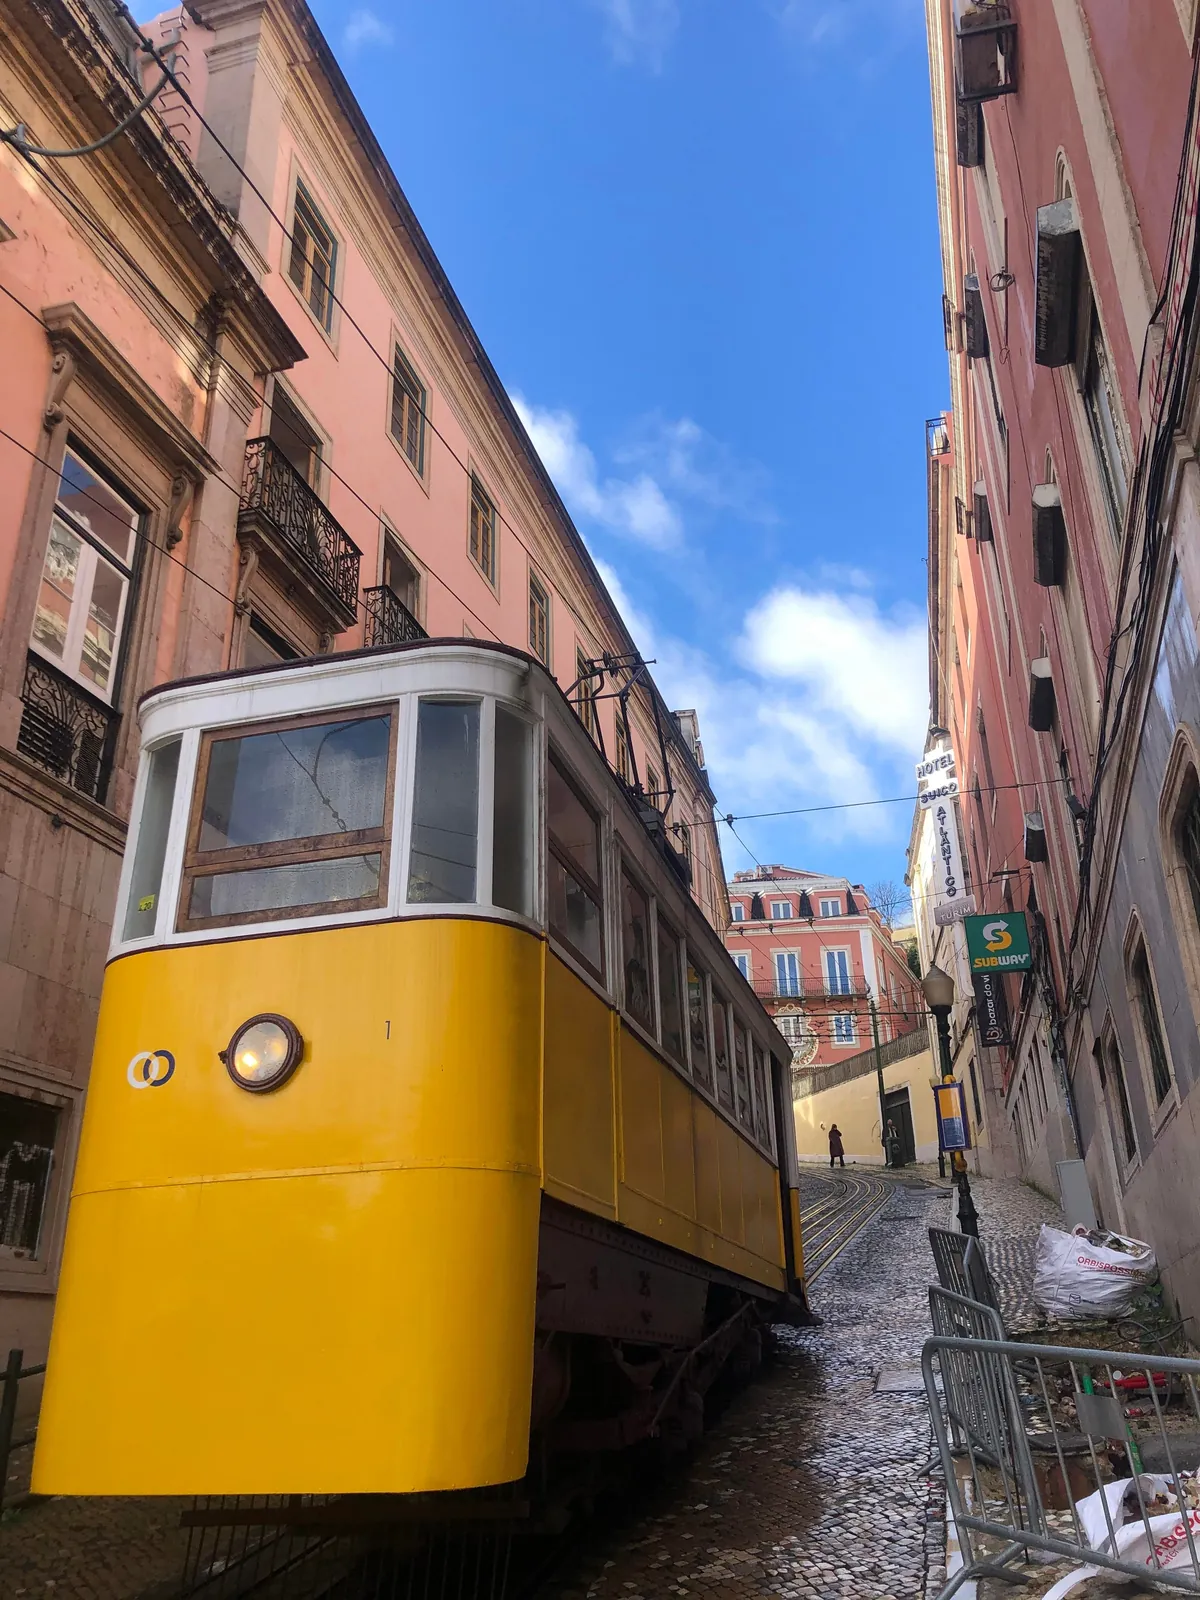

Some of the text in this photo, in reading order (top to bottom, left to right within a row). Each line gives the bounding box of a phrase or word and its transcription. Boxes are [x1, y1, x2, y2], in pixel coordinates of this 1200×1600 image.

[916, 753, 955, 779] HOTEL
[939, 905, 971, 921] TURIM
[973, 954, 1029, 969] SUBWAY
[983, 984, 993, 998] do
[986, 998, 998, 1026] bazar
[384, 1020, 391, 1040] 1
